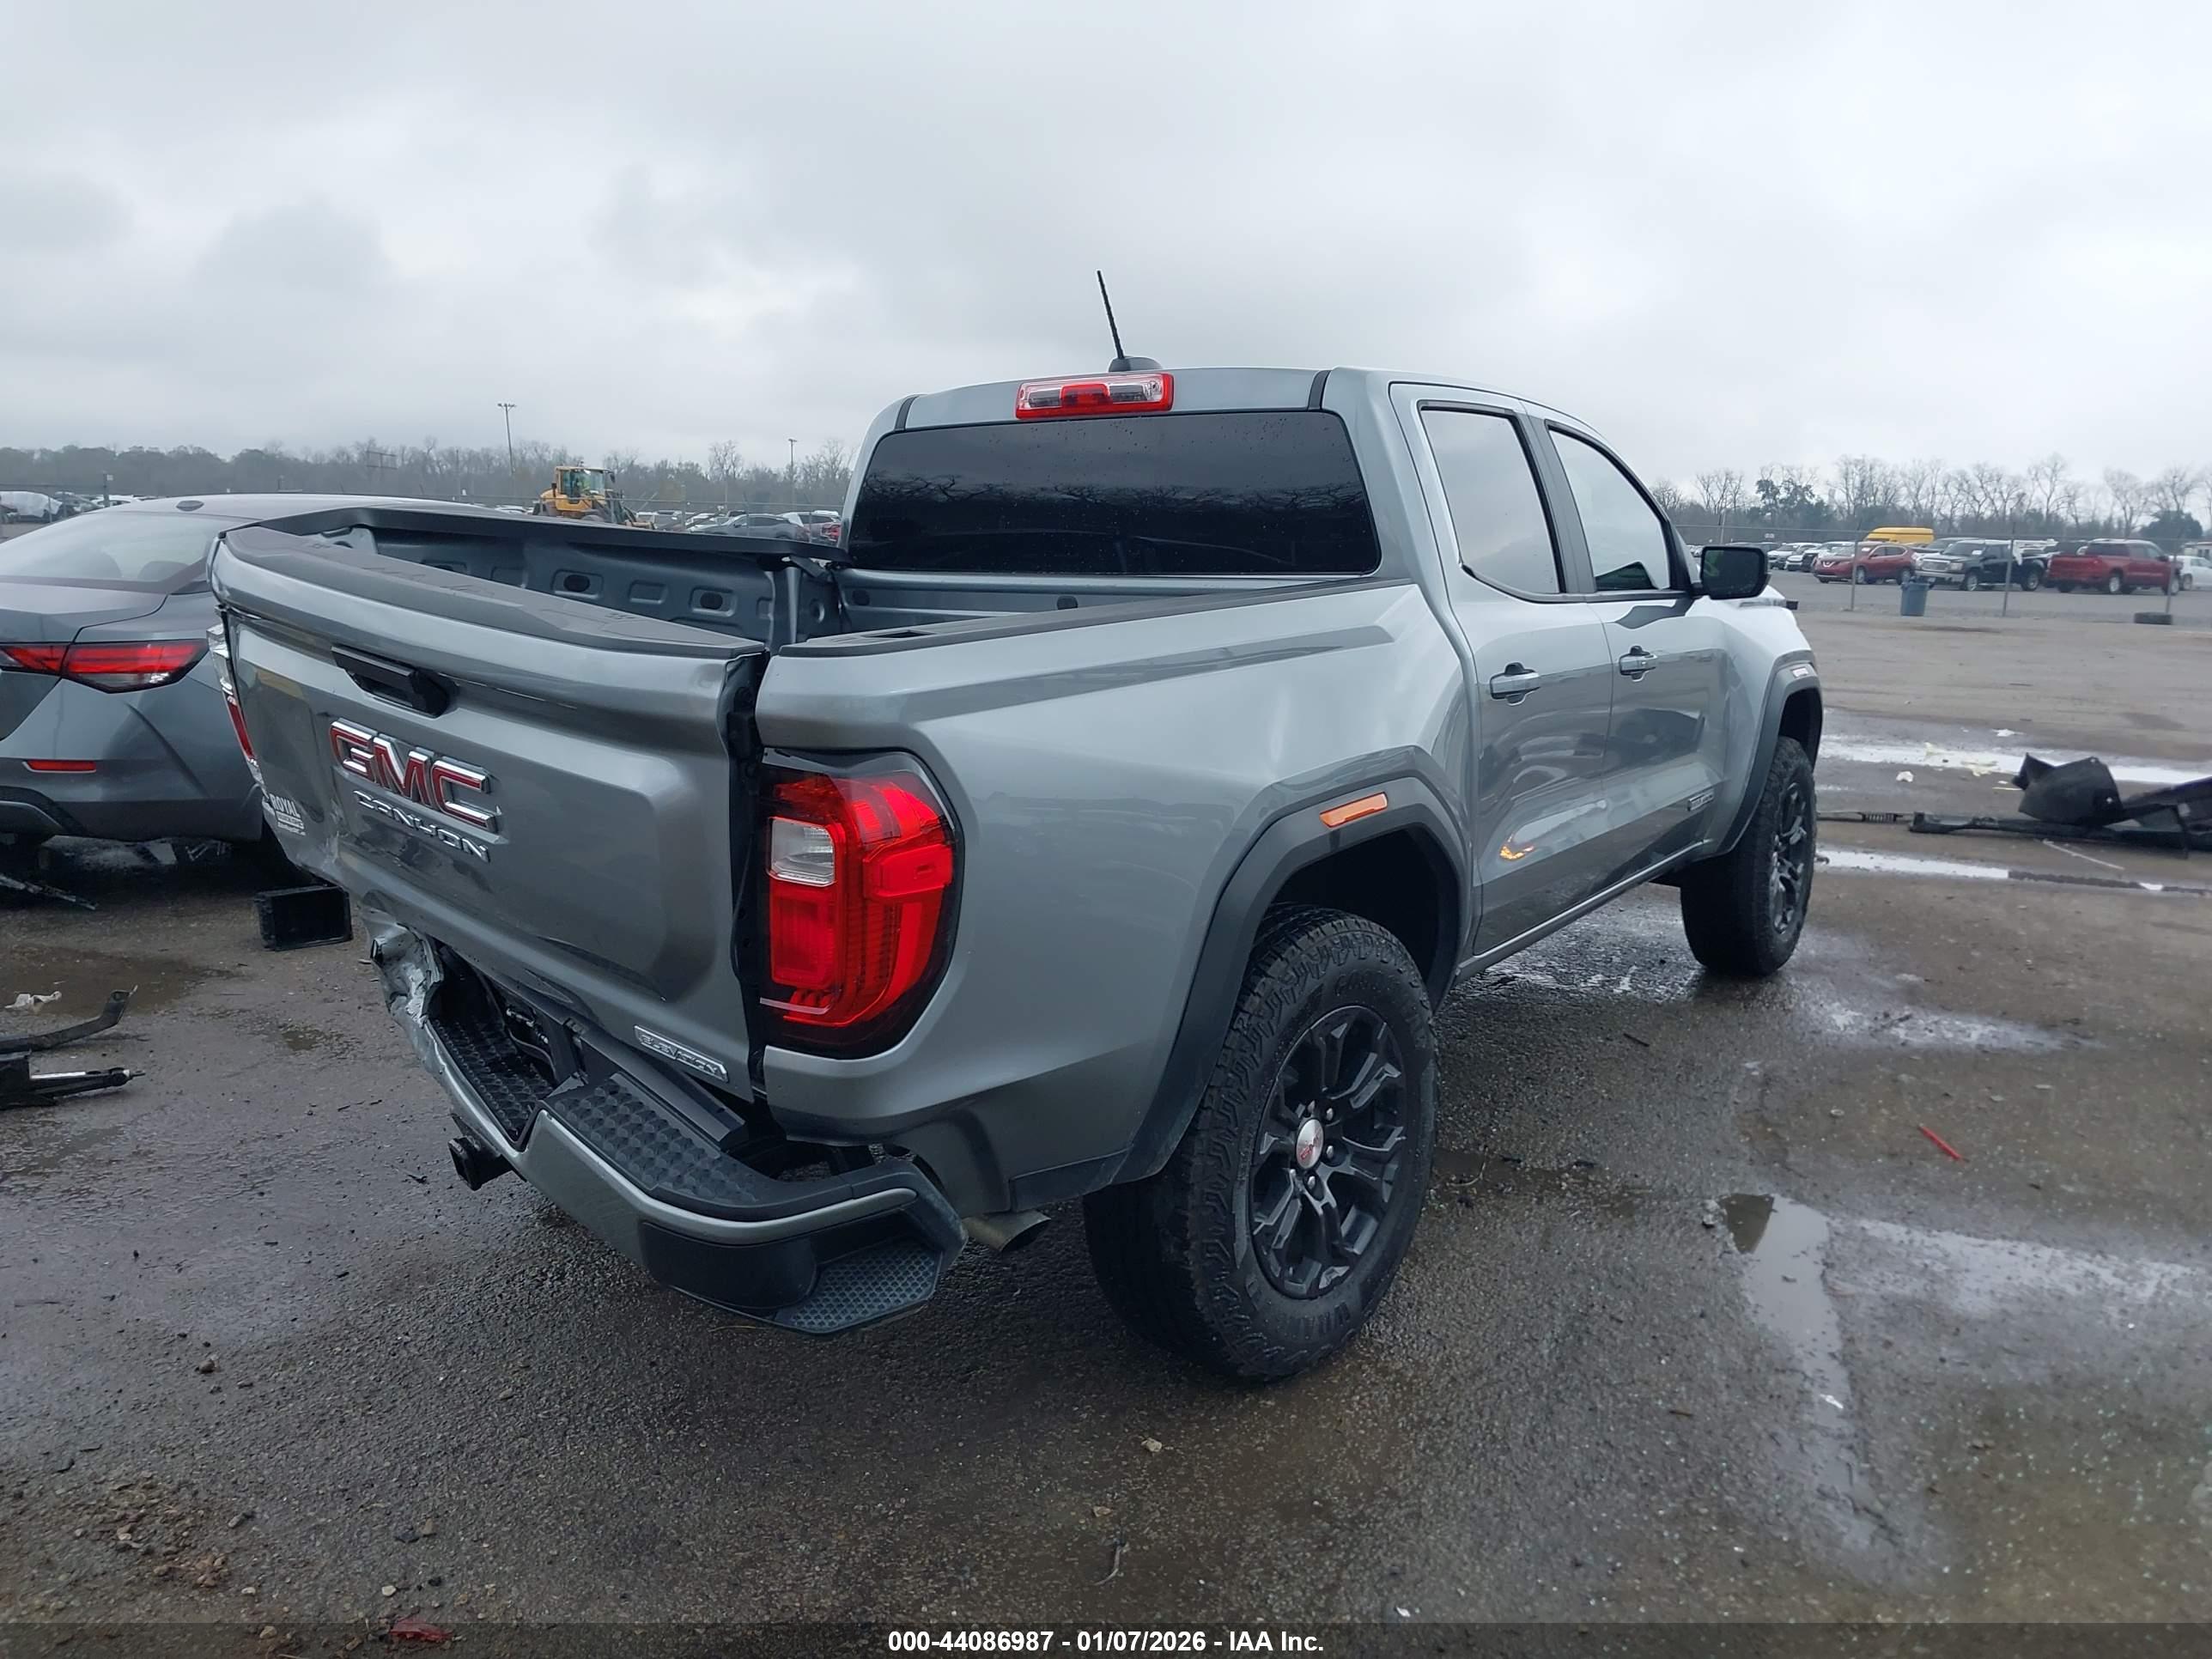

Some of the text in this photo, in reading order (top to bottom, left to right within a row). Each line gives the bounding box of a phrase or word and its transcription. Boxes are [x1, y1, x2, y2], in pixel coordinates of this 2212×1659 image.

[269, 793, 301, 818] ROYAL
[330, 720, 497, 833] GMC
[353, 790, 490, 862] CANYON
